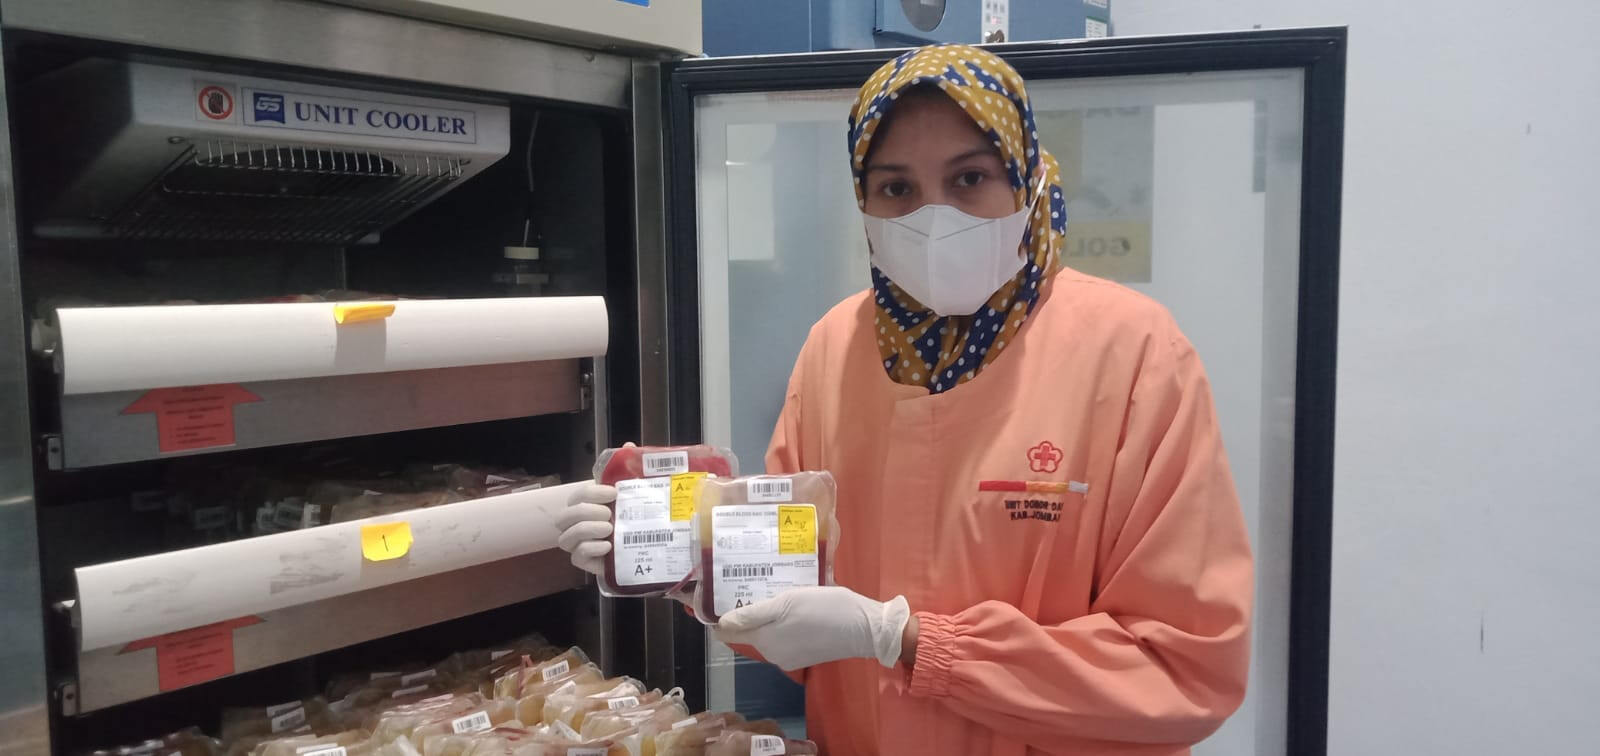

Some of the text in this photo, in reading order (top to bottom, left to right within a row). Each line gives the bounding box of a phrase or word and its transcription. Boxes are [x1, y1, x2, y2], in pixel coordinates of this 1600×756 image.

[294, 101, 467, 135] UNIT COOLER
[675, 483, 684, 492] A
[784, 515, 792, 525] A
[634, 564, 653, 576] A+
